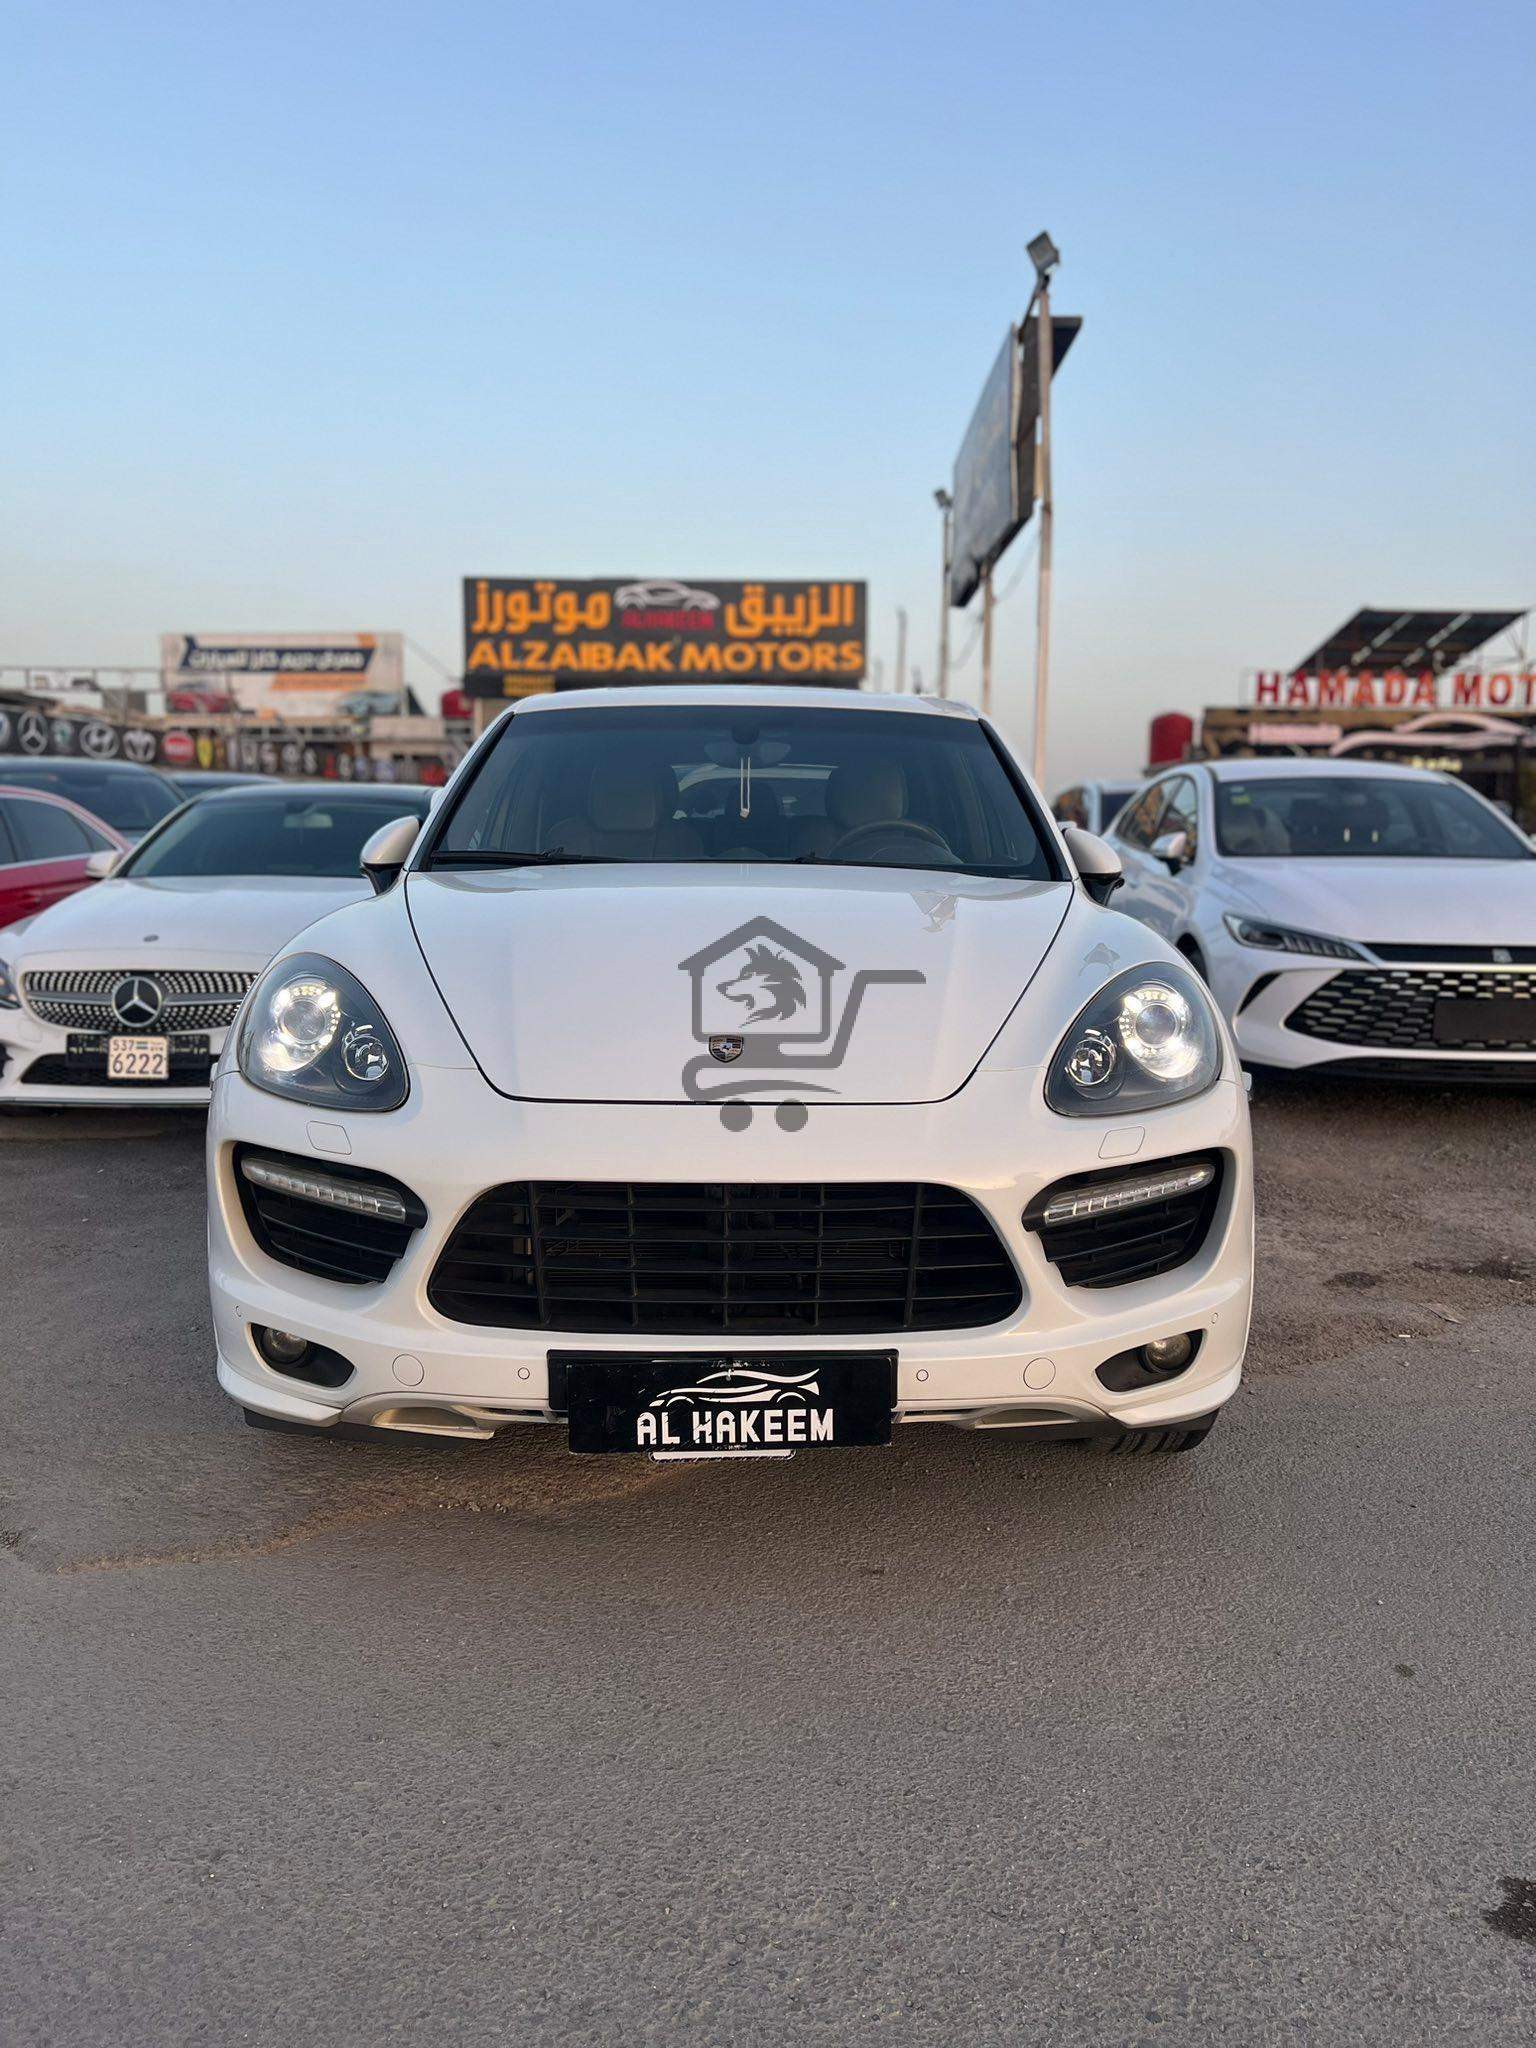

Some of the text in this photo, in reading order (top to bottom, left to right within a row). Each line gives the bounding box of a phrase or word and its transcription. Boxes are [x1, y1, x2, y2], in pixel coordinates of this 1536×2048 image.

[471, 580, 855, 638] الزيبق موتورز
[468, 640, 863, 672] ALZAIBAK MOTORS
[1256, 669, 1536, 706] HAMADA MOT
[112, 1053, 164, 1075] 6222
[636, 1408, 834, 1446] AL HAKEEM
